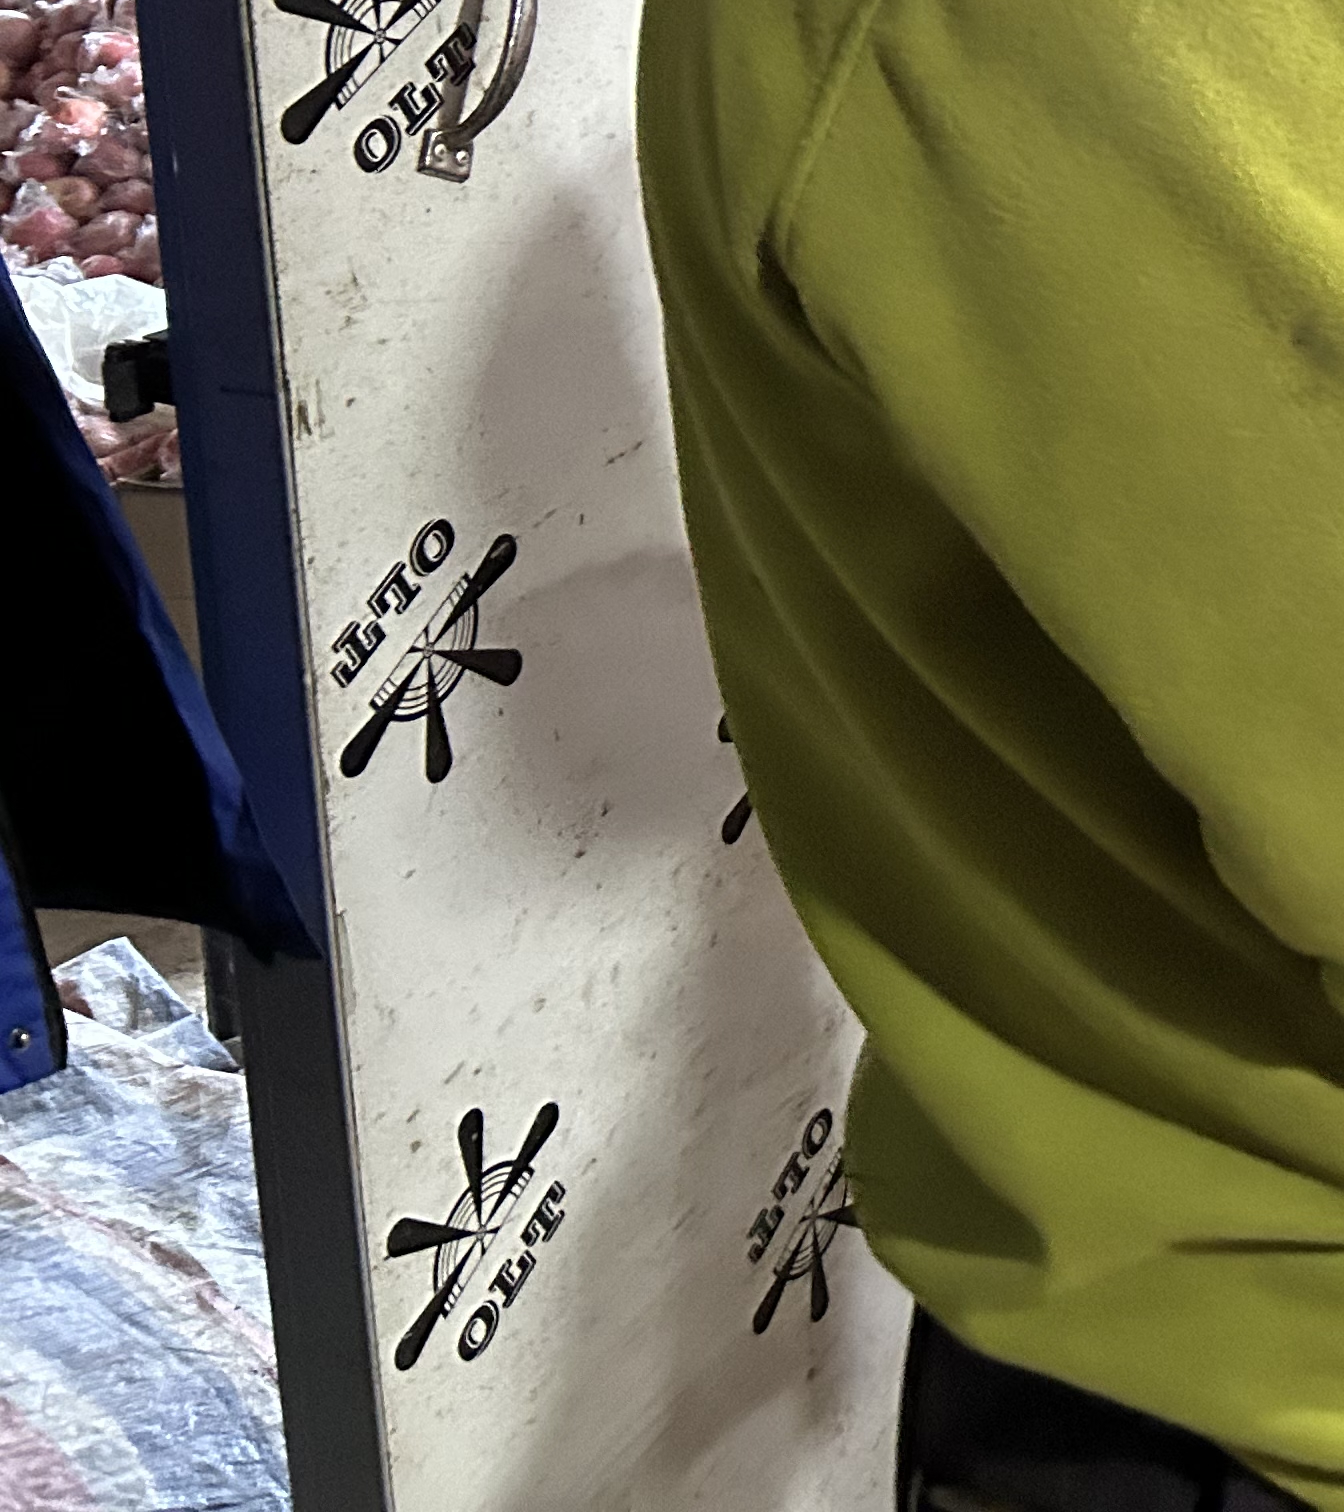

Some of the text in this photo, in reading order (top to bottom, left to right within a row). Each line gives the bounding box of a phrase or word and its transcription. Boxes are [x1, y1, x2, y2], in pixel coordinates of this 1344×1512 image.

[354, 22, 476, 172] OLT
[330, 518, 454, 688] OLT
[746, 1108, 832, 1266] OLT
[458, 1182, 566, 1362] OLT
